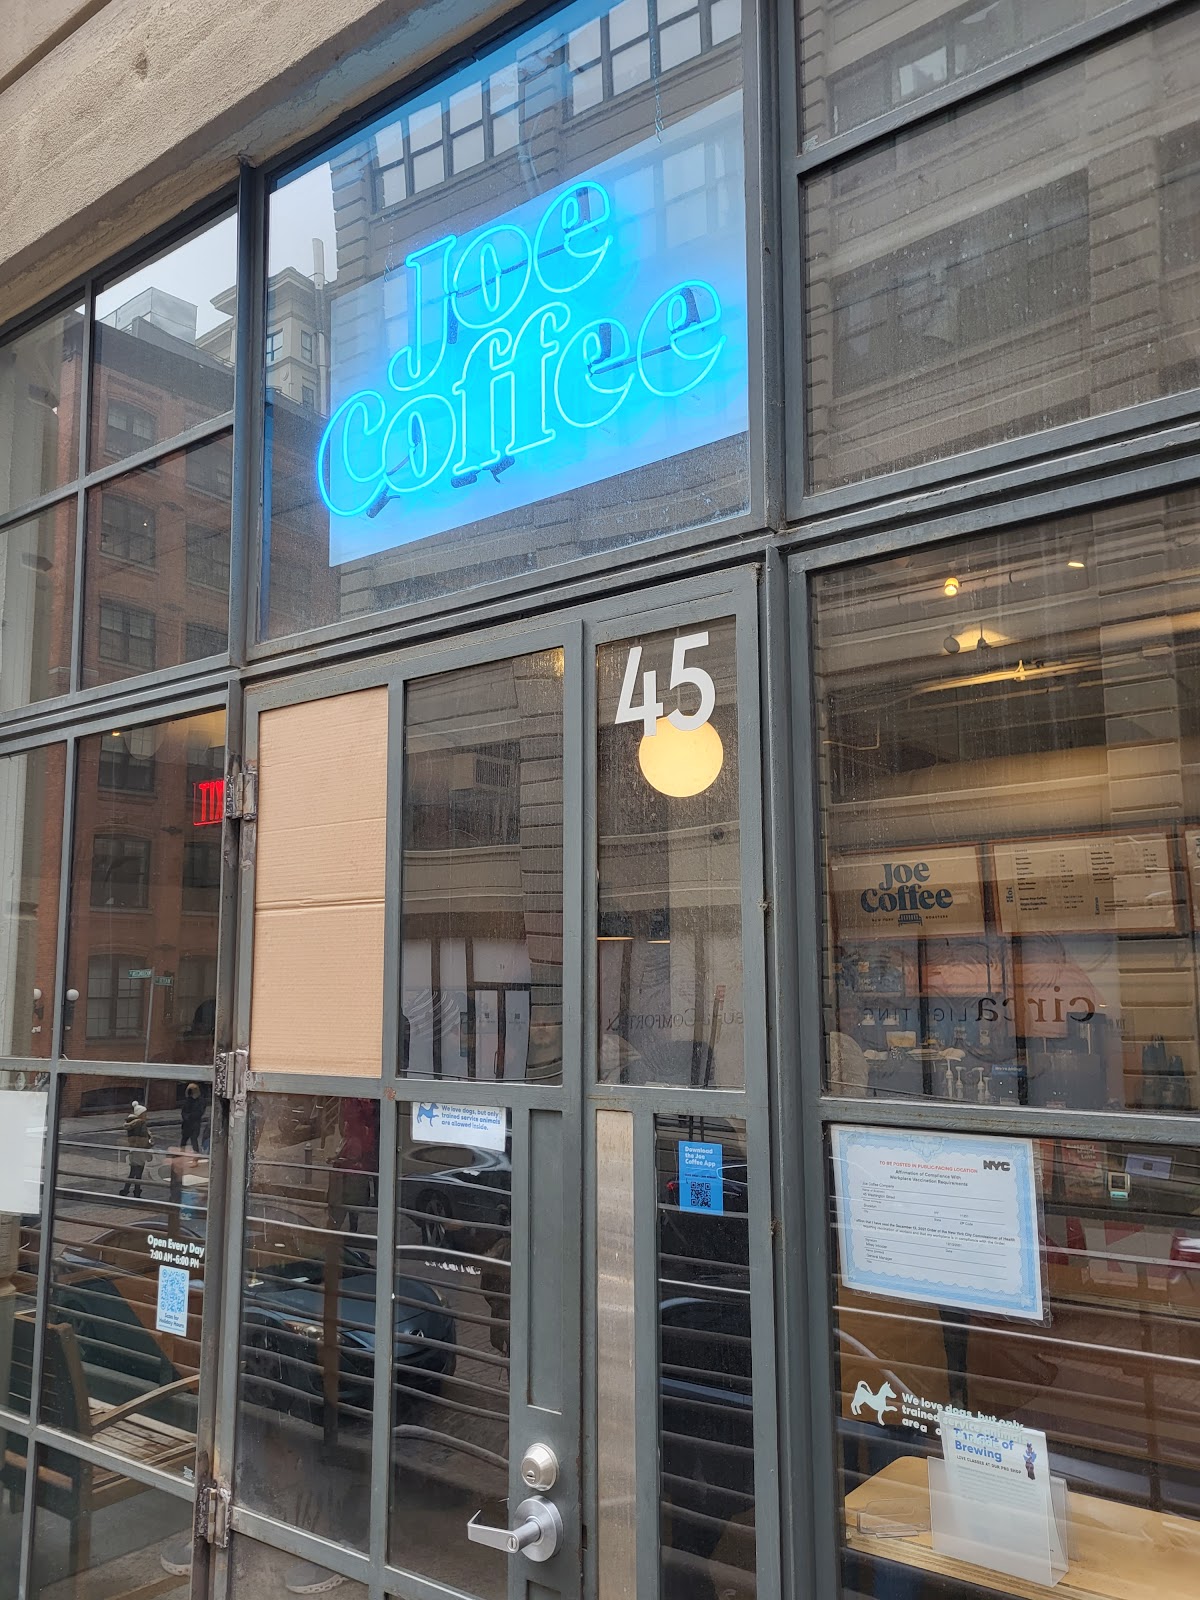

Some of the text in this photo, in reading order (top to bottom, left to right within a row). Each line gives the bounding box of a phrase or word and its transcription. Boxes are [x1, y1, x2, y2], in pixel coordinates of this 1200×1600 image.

[388, 181, 612, 391] Joe
[318, 280, 727, 516] Coffee
[614, 631, 716, 737] 45
[879, 862, 931, 891] Joe
[861, 883, 953, 913] Coffee
[441, 1112, 460, 1120] trained
[462, 1107, 476, 1115] dogs,
[487, 1110, 499, 1118] only
[451, 1120, 471, 1128] allowed
[472, 1123, 489, 1131] inside.
[684, 1146, 714, 1154] Download
[703, 1160, 716, 1168] App
[983, 1160, 1010, 1171] NYC
[953, 1166, 978, 1174] LOCATION
[938, 1179, 968, 1187] Requirements
[147, 1234, 205, 1258] Open Every Day
[149, 1249, 163, 1260] 7:00
[189, 1257, 200, 1269] PM
[901, 1392, 919, 1406] We
[921, 1397, 943, 1411] love
[978, 1411, 997, 1423] but
[998, 1415, 1024, 1430] only
[901, 1405, 939, 1422] trained
[901, 1418, 919, 1429] are
[1002, 1439, 1014, 1450] of
[954, 1439, 1003, 1462] Brewing
[967, 1457, 984, 1466] CLASSES
